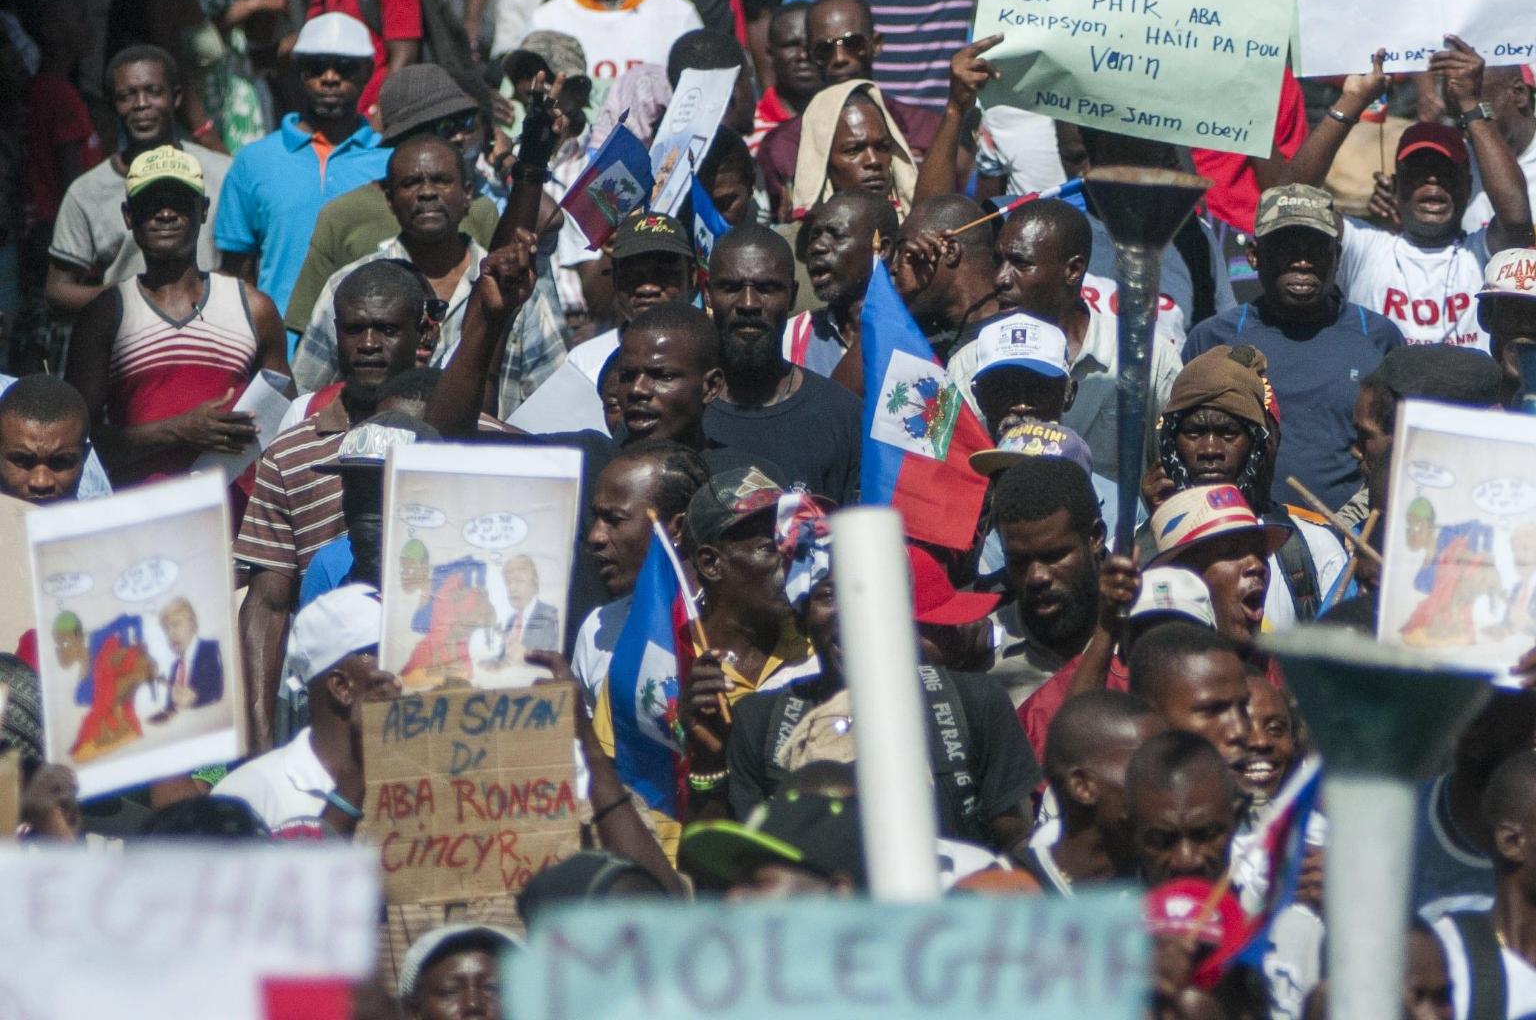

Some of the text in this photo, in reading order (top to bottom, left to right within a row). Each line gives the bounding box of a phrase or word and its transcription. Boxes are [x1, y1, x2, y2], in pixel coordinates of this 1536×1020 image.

[1189, 7, 1222, 27] ABA
[1212, 35, 1235, 53] PA
[1078, 98, 1114, 118] PAP
[1383, 287, 1470, 326] ROP
[382, 690, 566, 743] ABA SATAN
[376, 778, 577, 824] ABA RONSA
